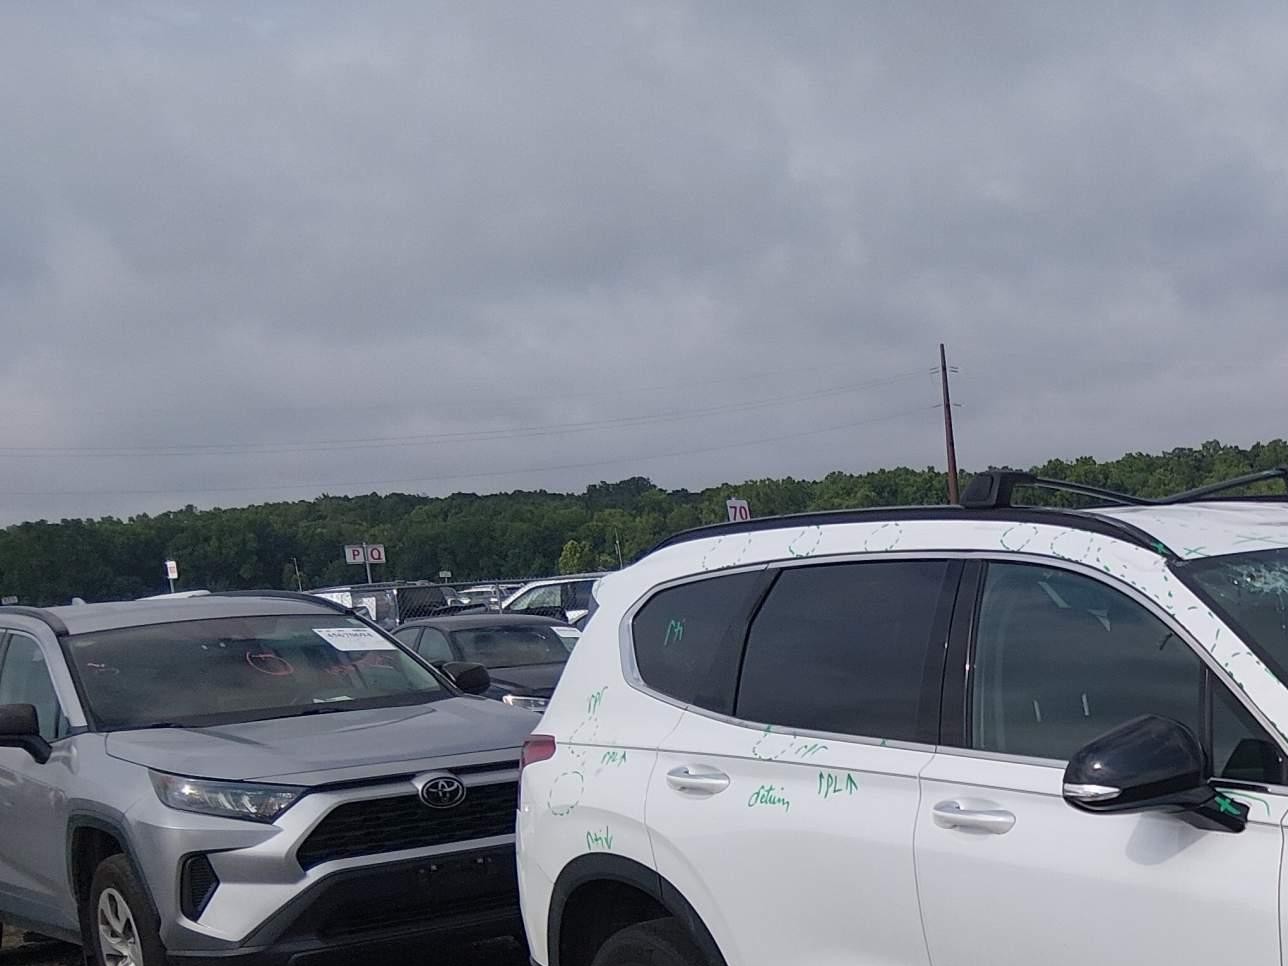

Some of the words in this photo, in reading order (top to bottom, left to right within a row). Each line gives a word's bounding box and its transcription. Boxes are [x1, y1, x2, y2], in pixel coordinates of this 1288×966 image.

[729, 505, 748, 521] 70
[352, 549, 360, 561] P
[370, 547, 383, 560] Q
